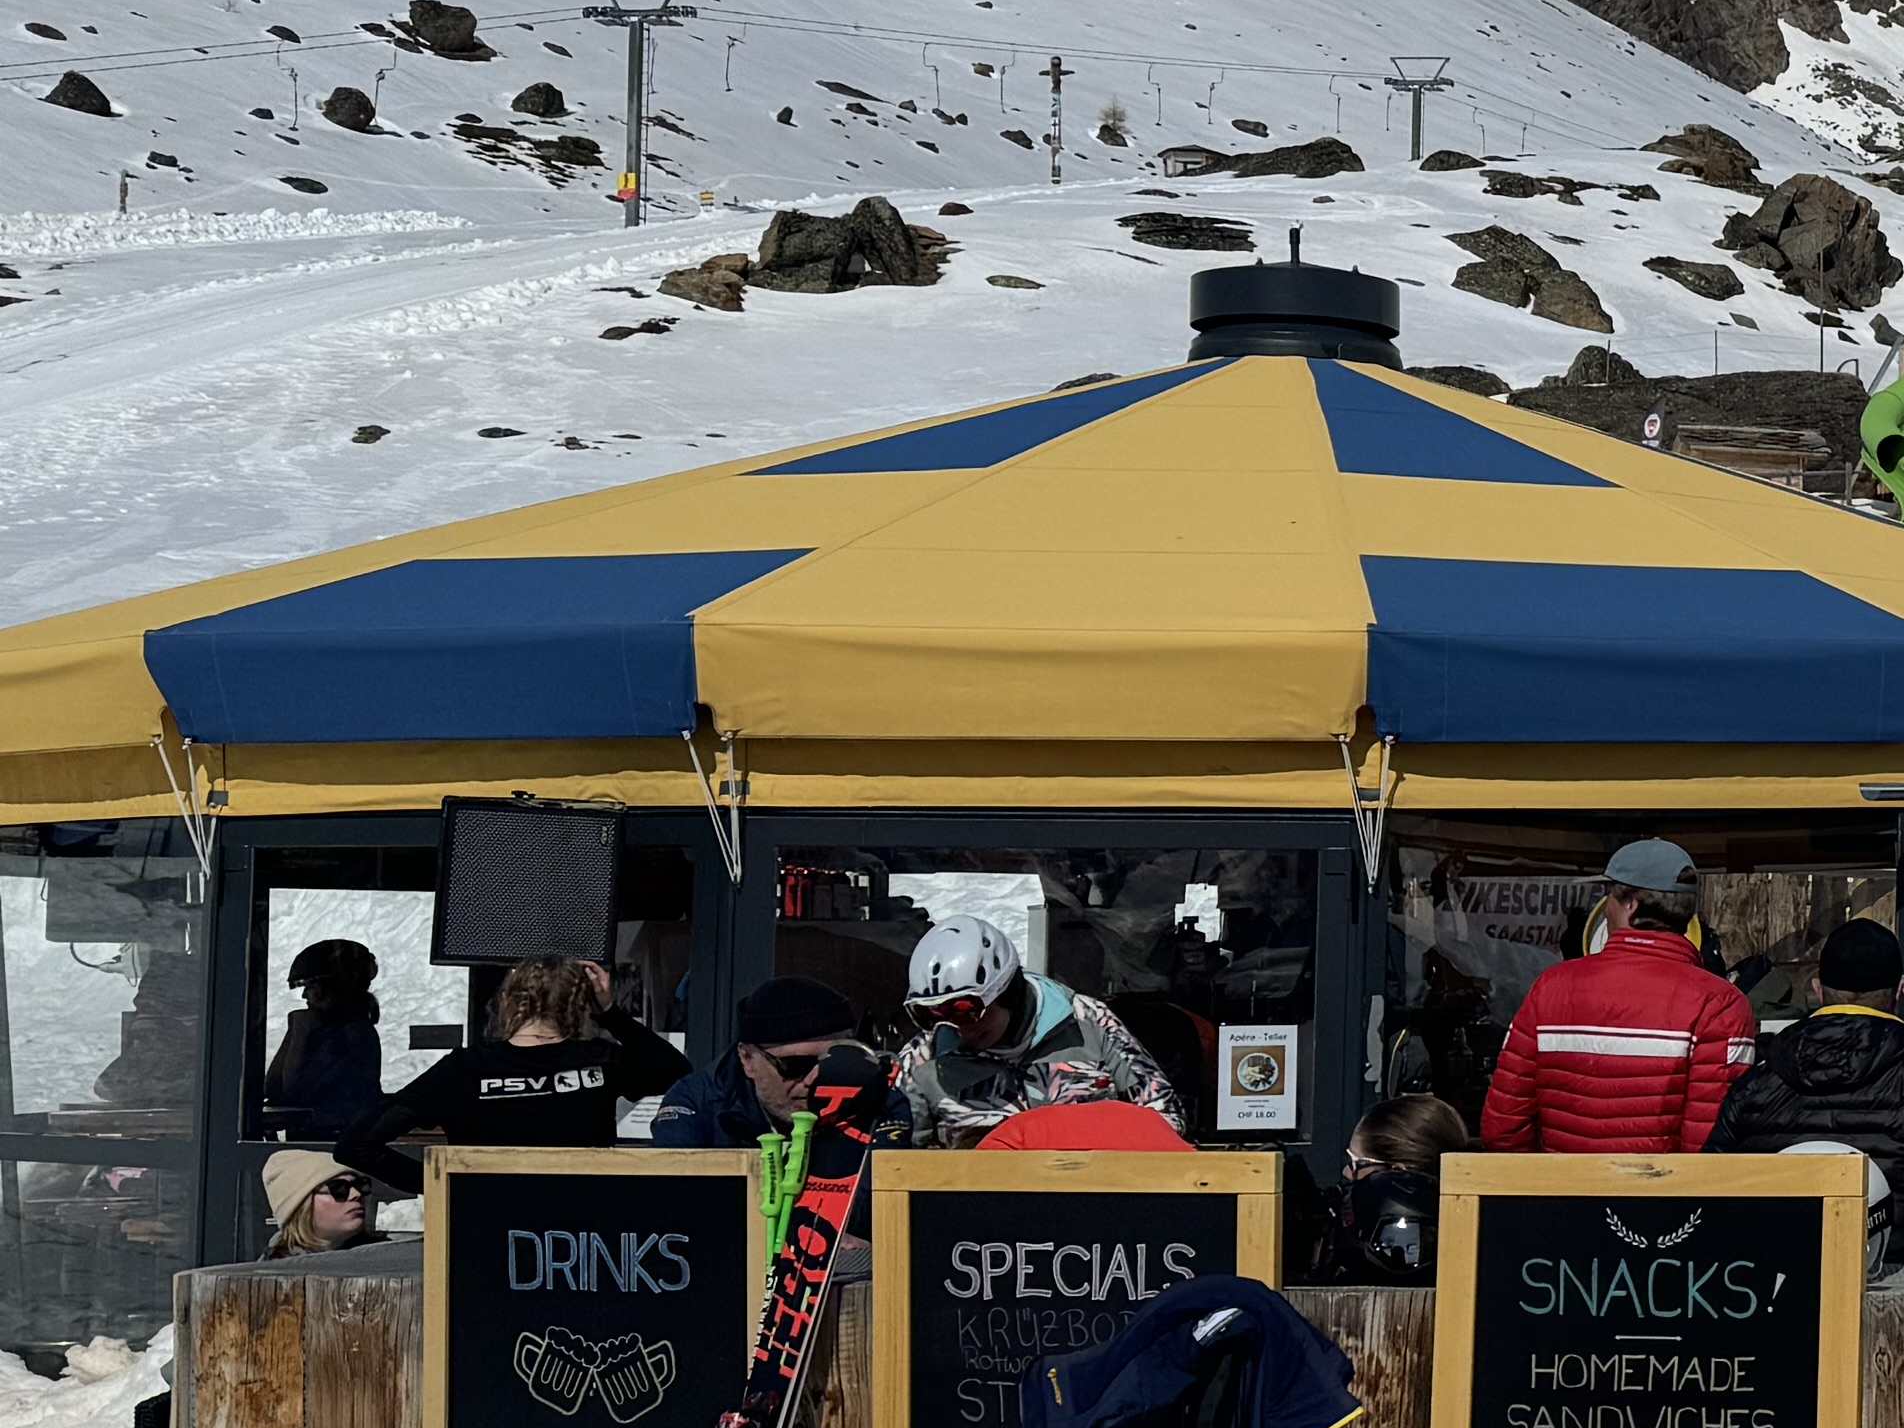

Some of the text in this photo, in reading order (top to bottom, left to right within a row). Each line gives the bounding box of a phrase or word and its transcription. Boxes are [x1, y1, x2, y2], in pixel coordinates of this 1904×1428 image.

[480, 1075, 547, 1093] PSV
[508, 1229, 691, 1294] DRINKS
[943, 1241, 1196, 1301] SPECIALS
[1518, 1257, 1787, 1319] SNACKS!
[1530, 1353, 1756, 1392] HOMEMADE
[957, 1377, 1024, 1423] ST
